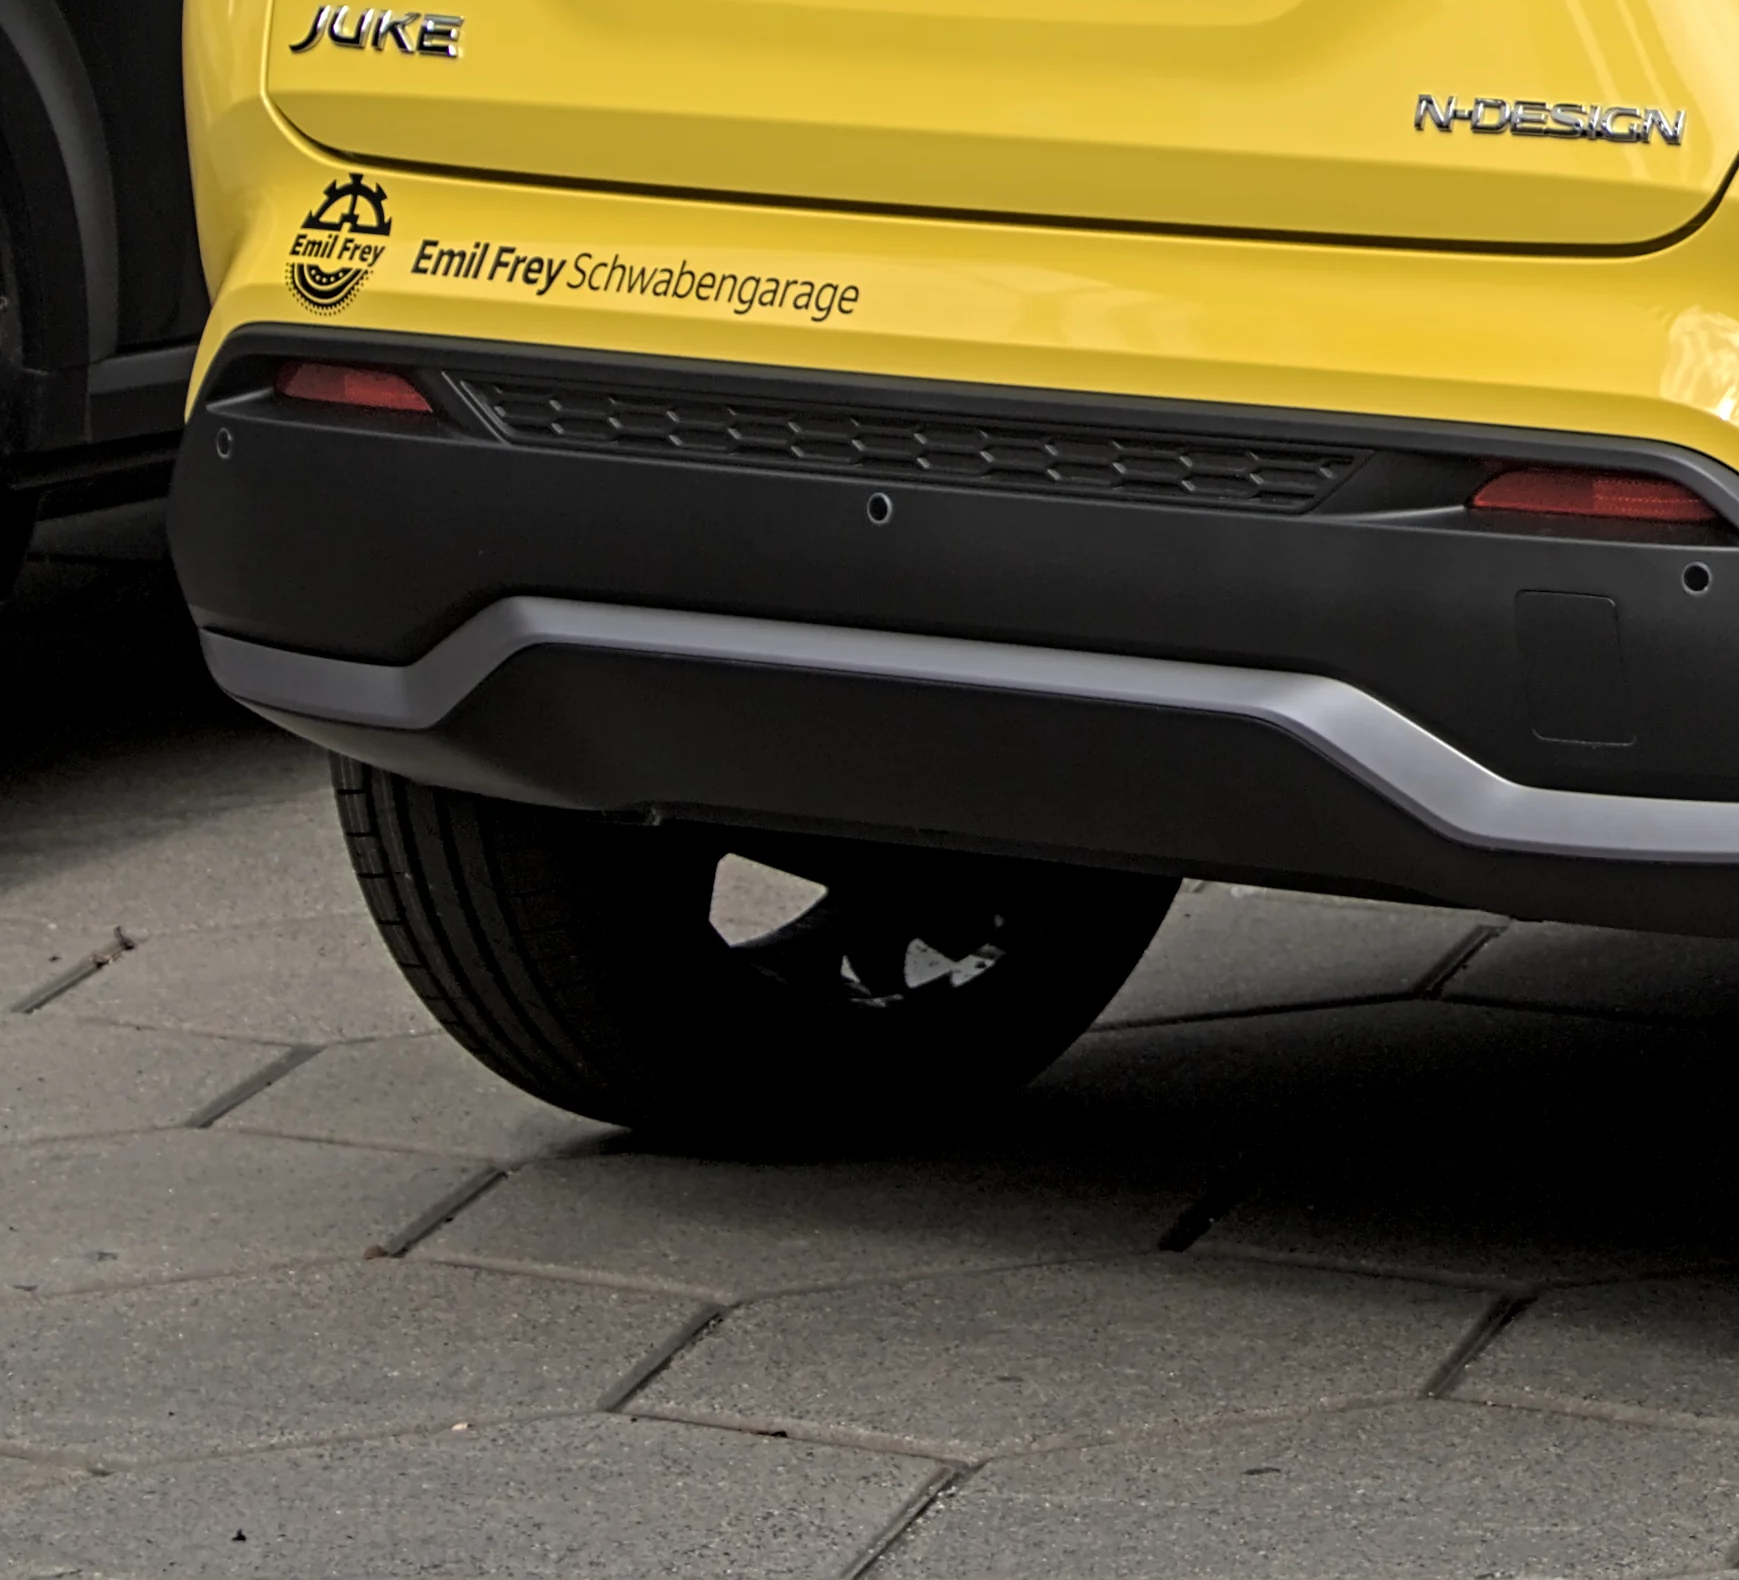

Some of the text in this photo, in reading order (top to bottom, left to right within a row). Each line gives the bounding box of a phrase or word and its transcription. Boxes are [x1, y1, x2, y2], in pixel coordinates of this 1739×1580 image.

[289, 4, 465, 60] JUKE
[1413, 93, 1688, 146] N-DESIGN
[289, 232, 386, 268] Emil Frey
[410, 238, 860, 322] Emil Frey Schwabengarage
